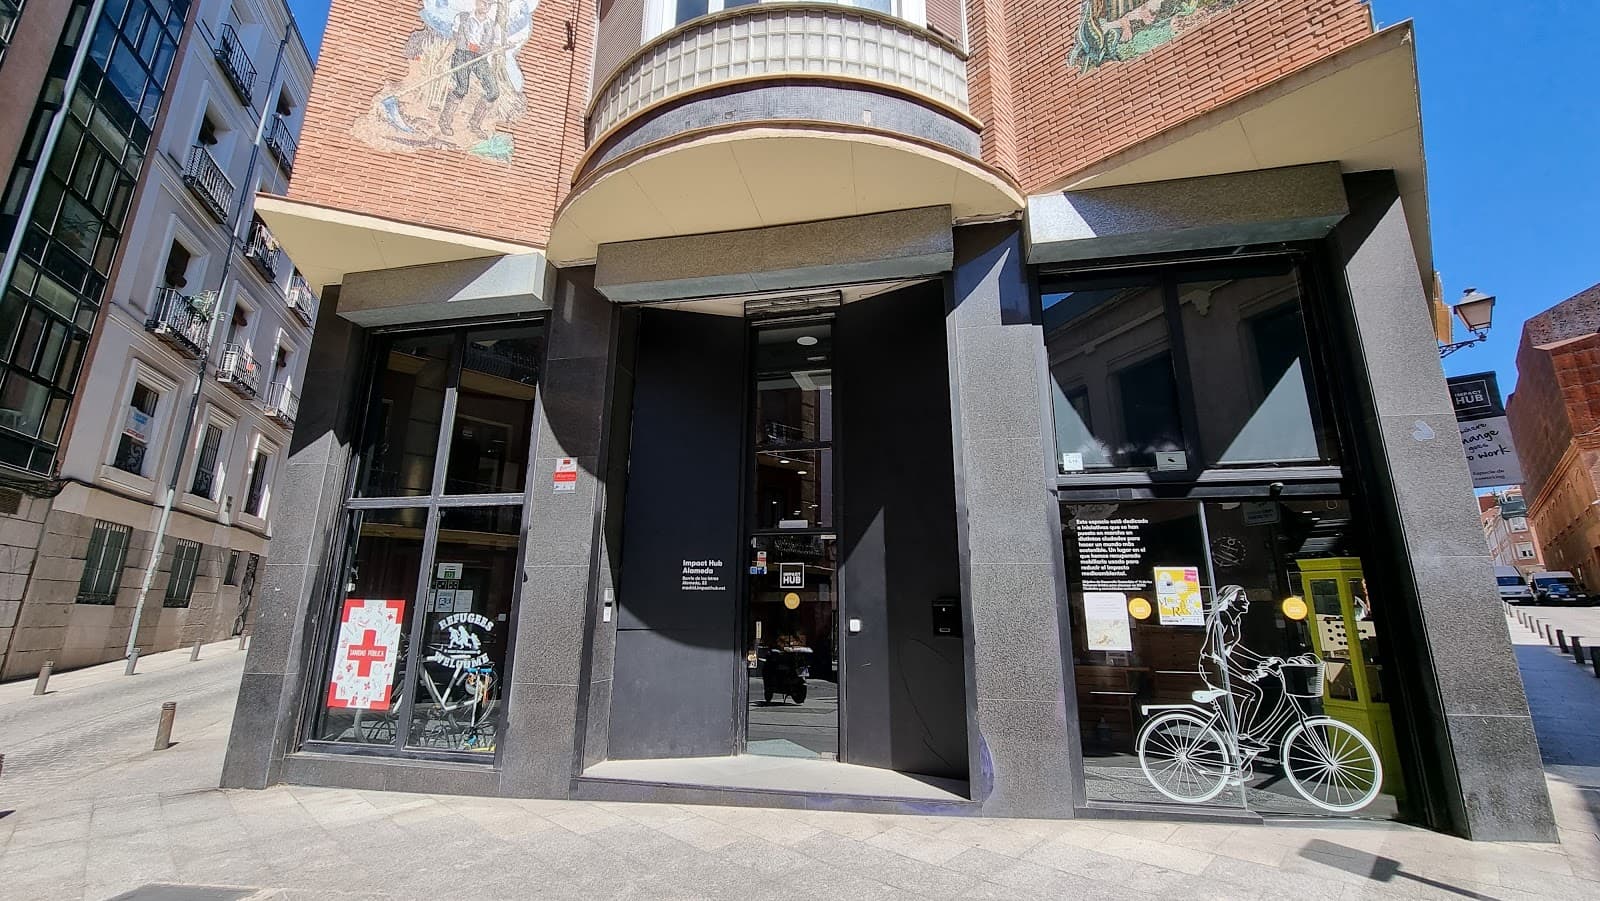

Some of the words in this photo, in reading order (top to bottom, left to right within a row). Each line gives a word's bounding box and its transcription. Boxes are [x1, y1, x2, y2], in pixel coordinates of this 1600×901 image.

[1455, 395, 1484, 405] HUB
[1478, 444, 1511, 458] work
[783, 576, 801, 584] HUB
[438, 613, 495, 632] REFUGEES
